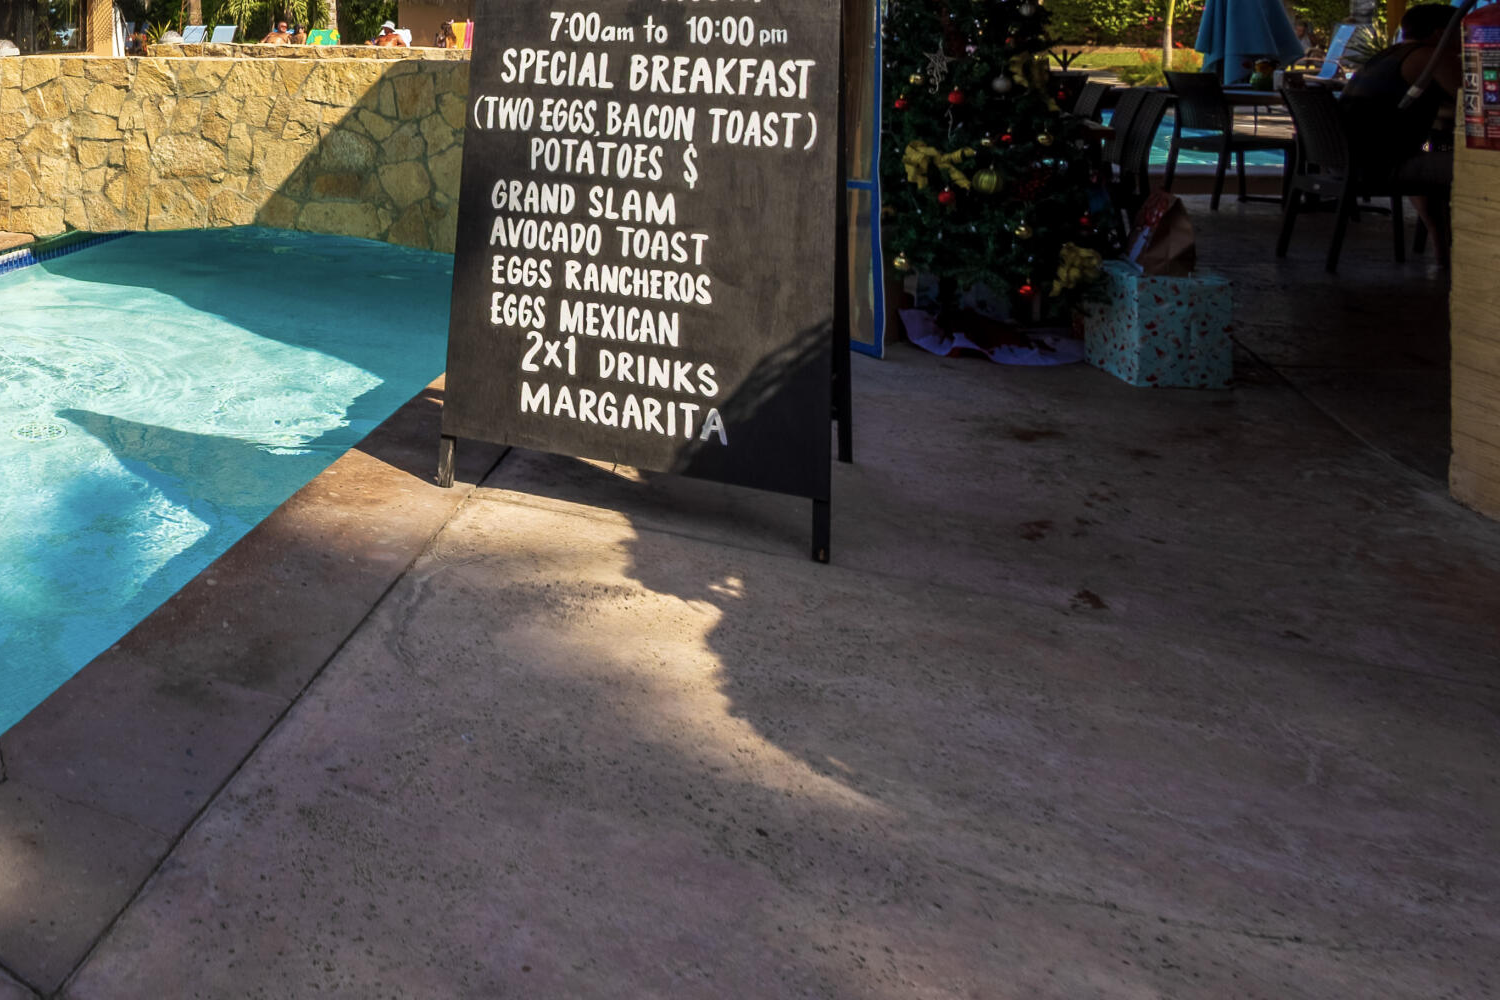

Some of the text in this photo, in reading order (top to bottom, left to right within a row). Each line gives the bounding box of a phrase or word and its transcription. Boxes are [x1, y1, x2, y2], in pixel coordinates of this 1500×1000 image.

[642, 14, 669, 44] to
[500, 47, 817, 100] SPECIAL BREAKFAST
[473, 94, 535, 132] (TWO
[530, 137, 699, 190] POTATOES $
[491, 178, 677, 226] GRAND SLAM
[489, 215, 710, 266] AVOCADO TOAST
[491, 254, 713, 306] EGGS RANCHEROS
[489, 291, 680, 348] EGGS MEXICAN
[598, 348, 720, 398] DRINKS
[520, 381, 729, 446] MARGARITA
